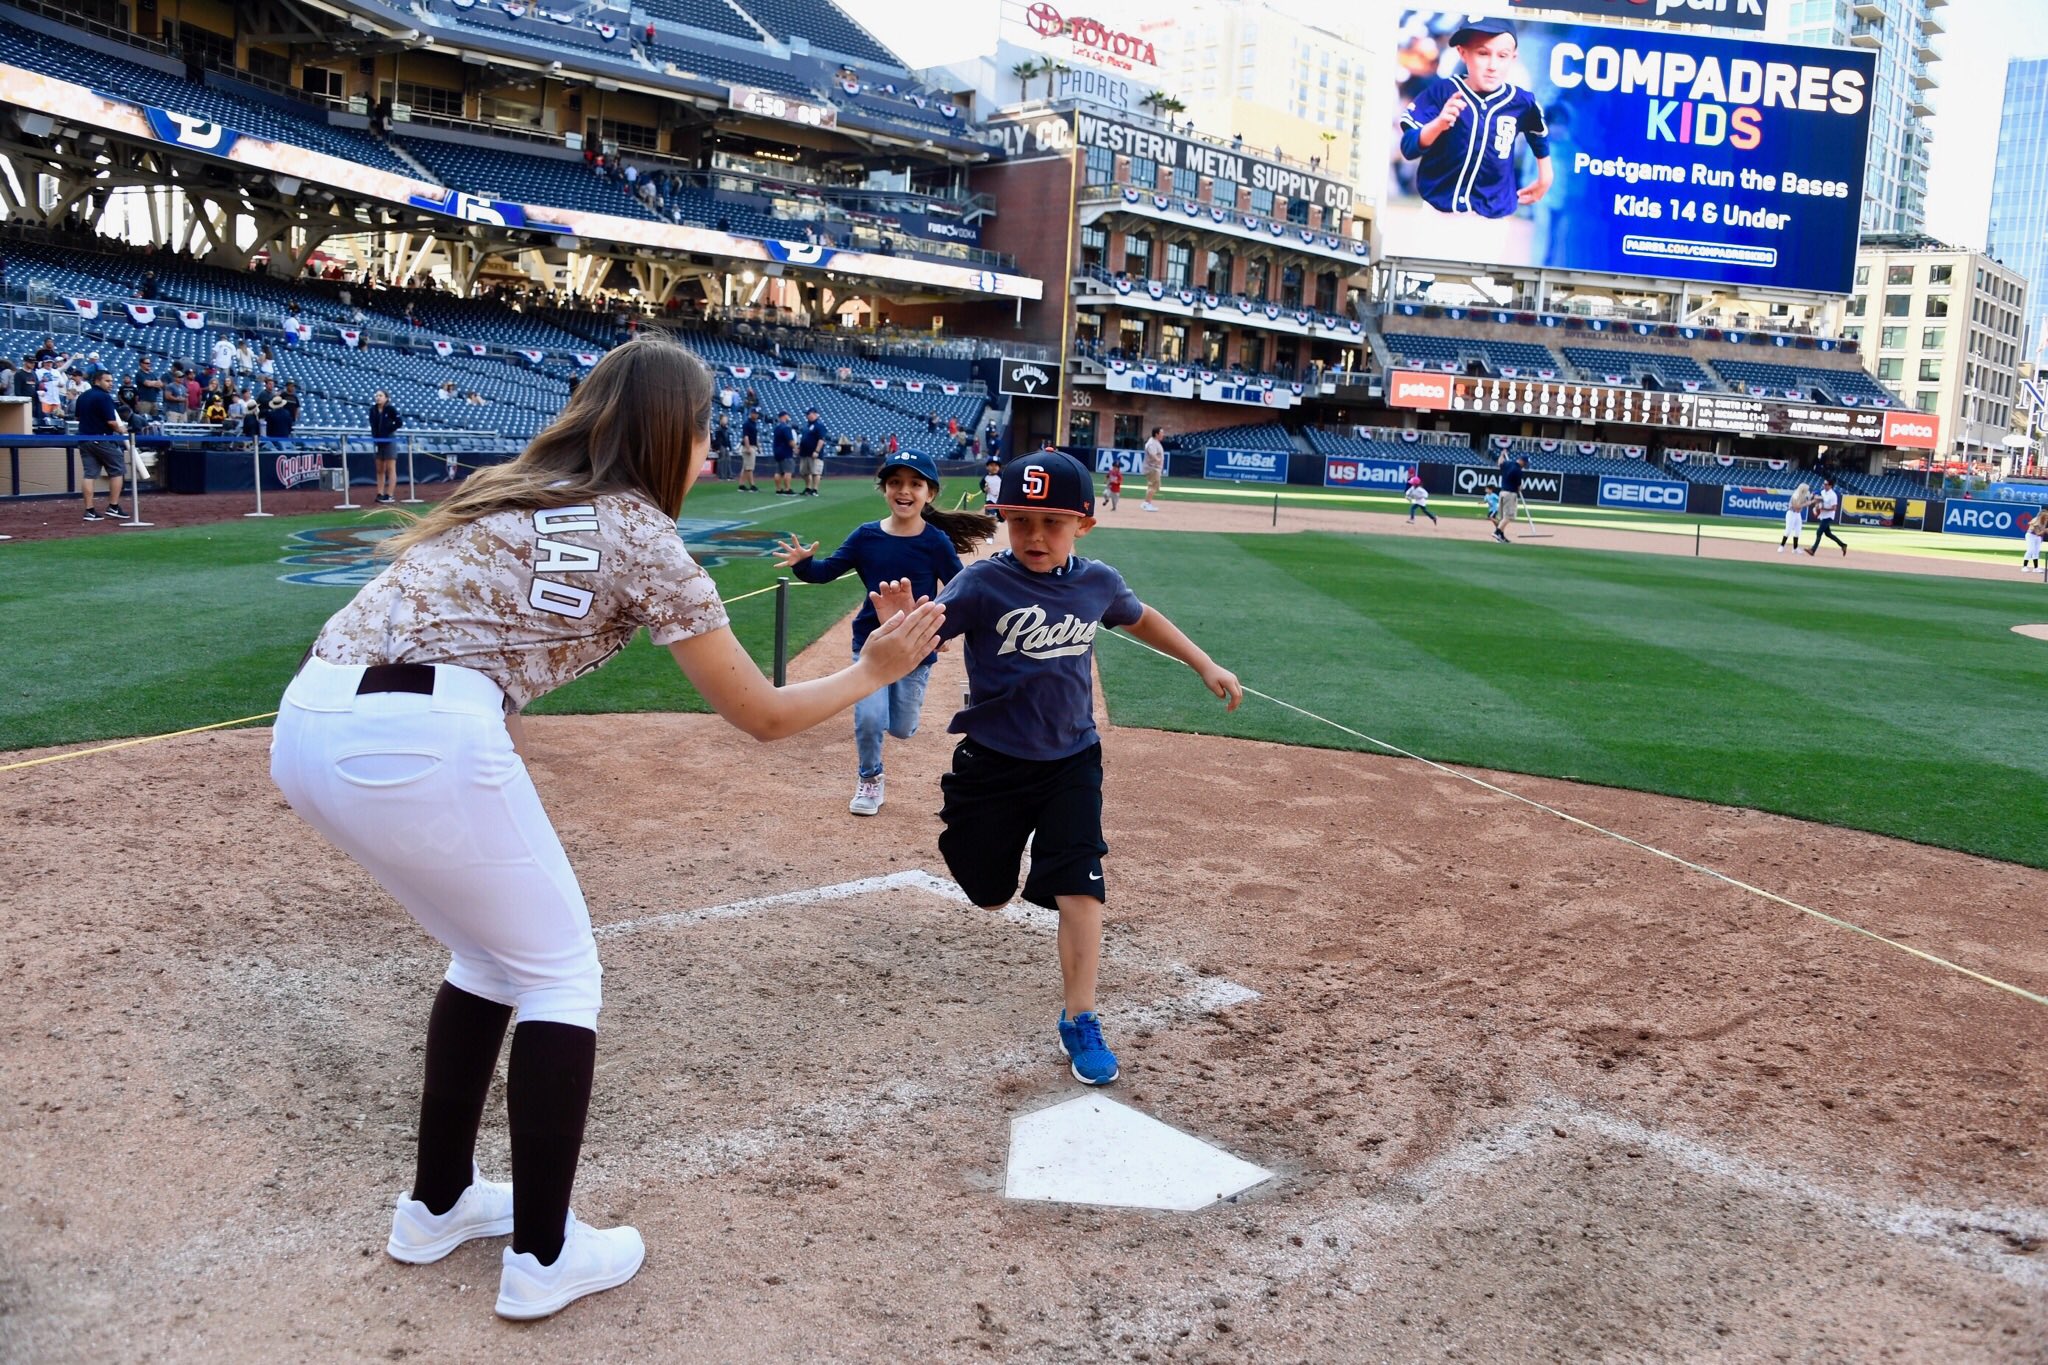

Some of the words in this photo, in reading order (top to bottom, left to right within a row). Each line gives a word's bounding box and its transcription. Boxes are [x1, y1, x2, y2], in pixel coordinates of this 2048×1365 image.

[1070, 16, 1157, 66] TOYOTA
[1060, 70, 1128, 108] PADRES
[1549, 42, 1865, 115] COMPADRES
[744, 94, 785, 117] 4:50
[1647, 99, 1762, 149] KIDS
[1078, 115, 1177, 165] WESTERN
[1185, 146, 1248, 184] METAL
[1253, 167, 1320, 202] SUPPLY
[1324, 184, 1352, 211] CO.
[1574, 153, 1686, 184] Postgame
[1691, 163, 1734, 188] Run
[1740, 168, 1776, 191] the
[1781, 172, 1848, 198] Bases
[1613, 194, 1662, 219] Kids
[1670, 199, 1696, 222] 14
[1702, 202, 1718, 224] &
[1723, 204, 1791, 230] Under
[1011, 363, 1049, 385] Callaway
[1071, 390, 1092, 407] 336
[1399, 382, 1445, 399] petco
[1556, 405, 1564, 416] 2
[1590, 408, 1595, 419] 1
[1662, 414, 1667, 425] 1
[1890, 421, 1933, 438] petco
[276, 454, 323, 485] CHOLULA
[1098, 451, 1167, 475] ASM
[1227, 451, 1276, 468] ViaSat
[1022, 465, 1050, 499] SD
[1602, 483, 1685, 505] GEICO
[1728, 494, 1789, 512] Southwes
[1947, 509, 2012, 530] ARCO
[527, 504, 602, 620] UAD
[996, 604, 1098, 660] Padre
